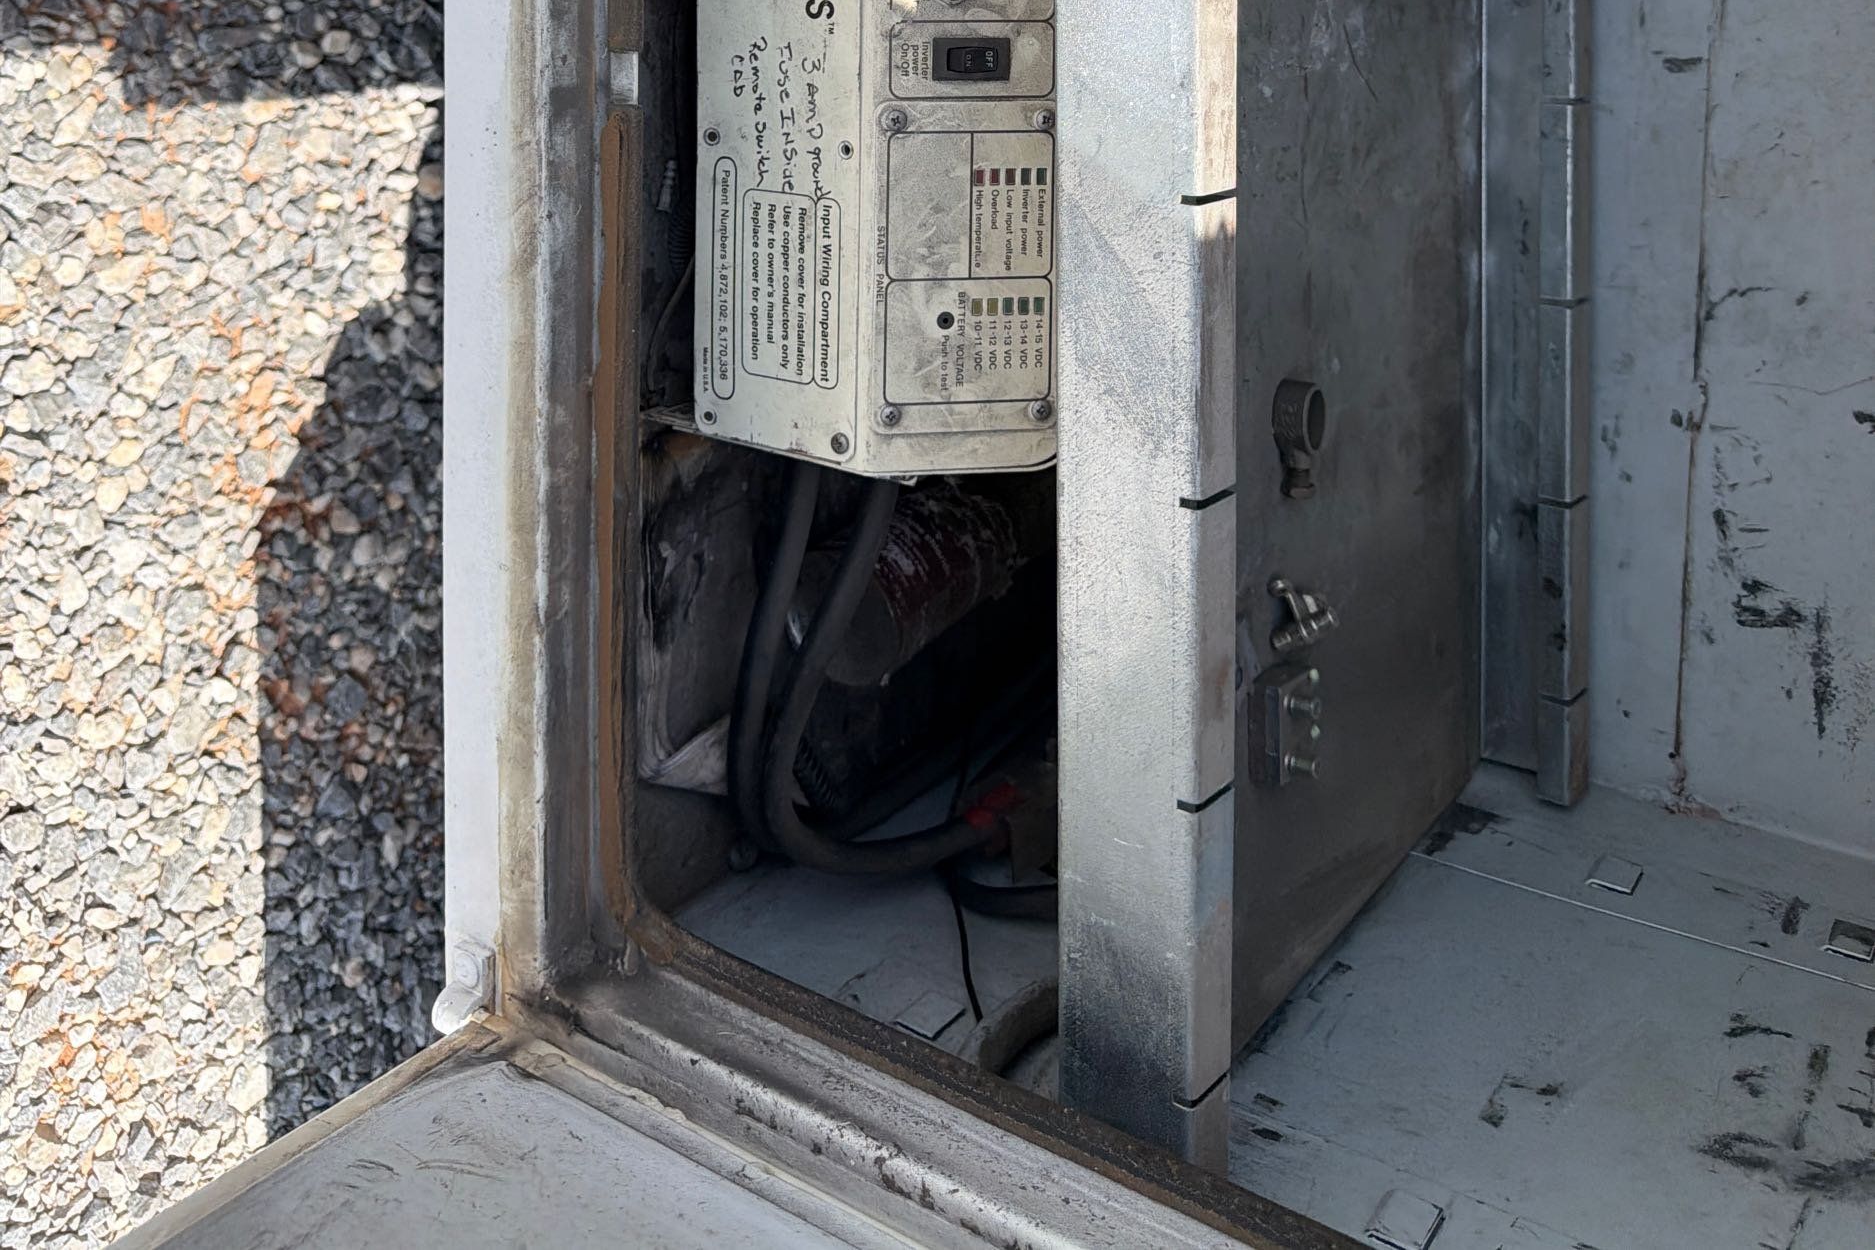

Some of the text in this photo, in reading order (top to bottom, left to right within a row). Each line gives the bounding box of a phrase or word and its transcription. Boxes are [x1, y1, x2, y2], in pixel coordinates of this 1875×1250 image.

[749, 36, 768, 116] Remote
[777, 42, 794, 103] Fuse
[802, 58, 821, 74] 3
[902, 43, 910, 77] On/Off
[910, 45, 919, 76] power
[922, 42, 930, 80] Inverter
[966, 54, 972, 66] ON
[720, 170, 730, 205] Patent
[990, 190, 999, 230] Overload
[720, 209, 730, 260] Numbers
[798, 207, 806, 254] Remove
[974, 190, 984, 268] High temperate
[1004, 189, 1014, 271] Low input voltage
[1020, 189, 1030, 256] Inverter power
[1036, 189, 1046, 258] External power
[750, 202, 761, 360] Replace cover for operation
[766, 204, 776, 344] Refer to owner's manual
[780, 205, 792, 370] Use copper conductors only
[876, 226, 885, 306] STATUS PANEL
[797, 293, 806, 308] for
[818, 204, 832, 382] Input Wiring Compartment
[718, 326, 728, 380] 5,170,336
[796, 312, 806, 376] installation
[940, 335, 949, 391] Push to test
[955, 292, 966, 388] BATTERY VOLTAGE
[974, 320, 982, 371] 10-11 VDC
[988, 320, 997, 370] 11-12 VDC
[1004, 320, 1012, 370] 12-13 VDC
[1020, 320, 1028, 370] 13-14 VDC
[1034, 319, 1042, 368] 14-15 VDC
